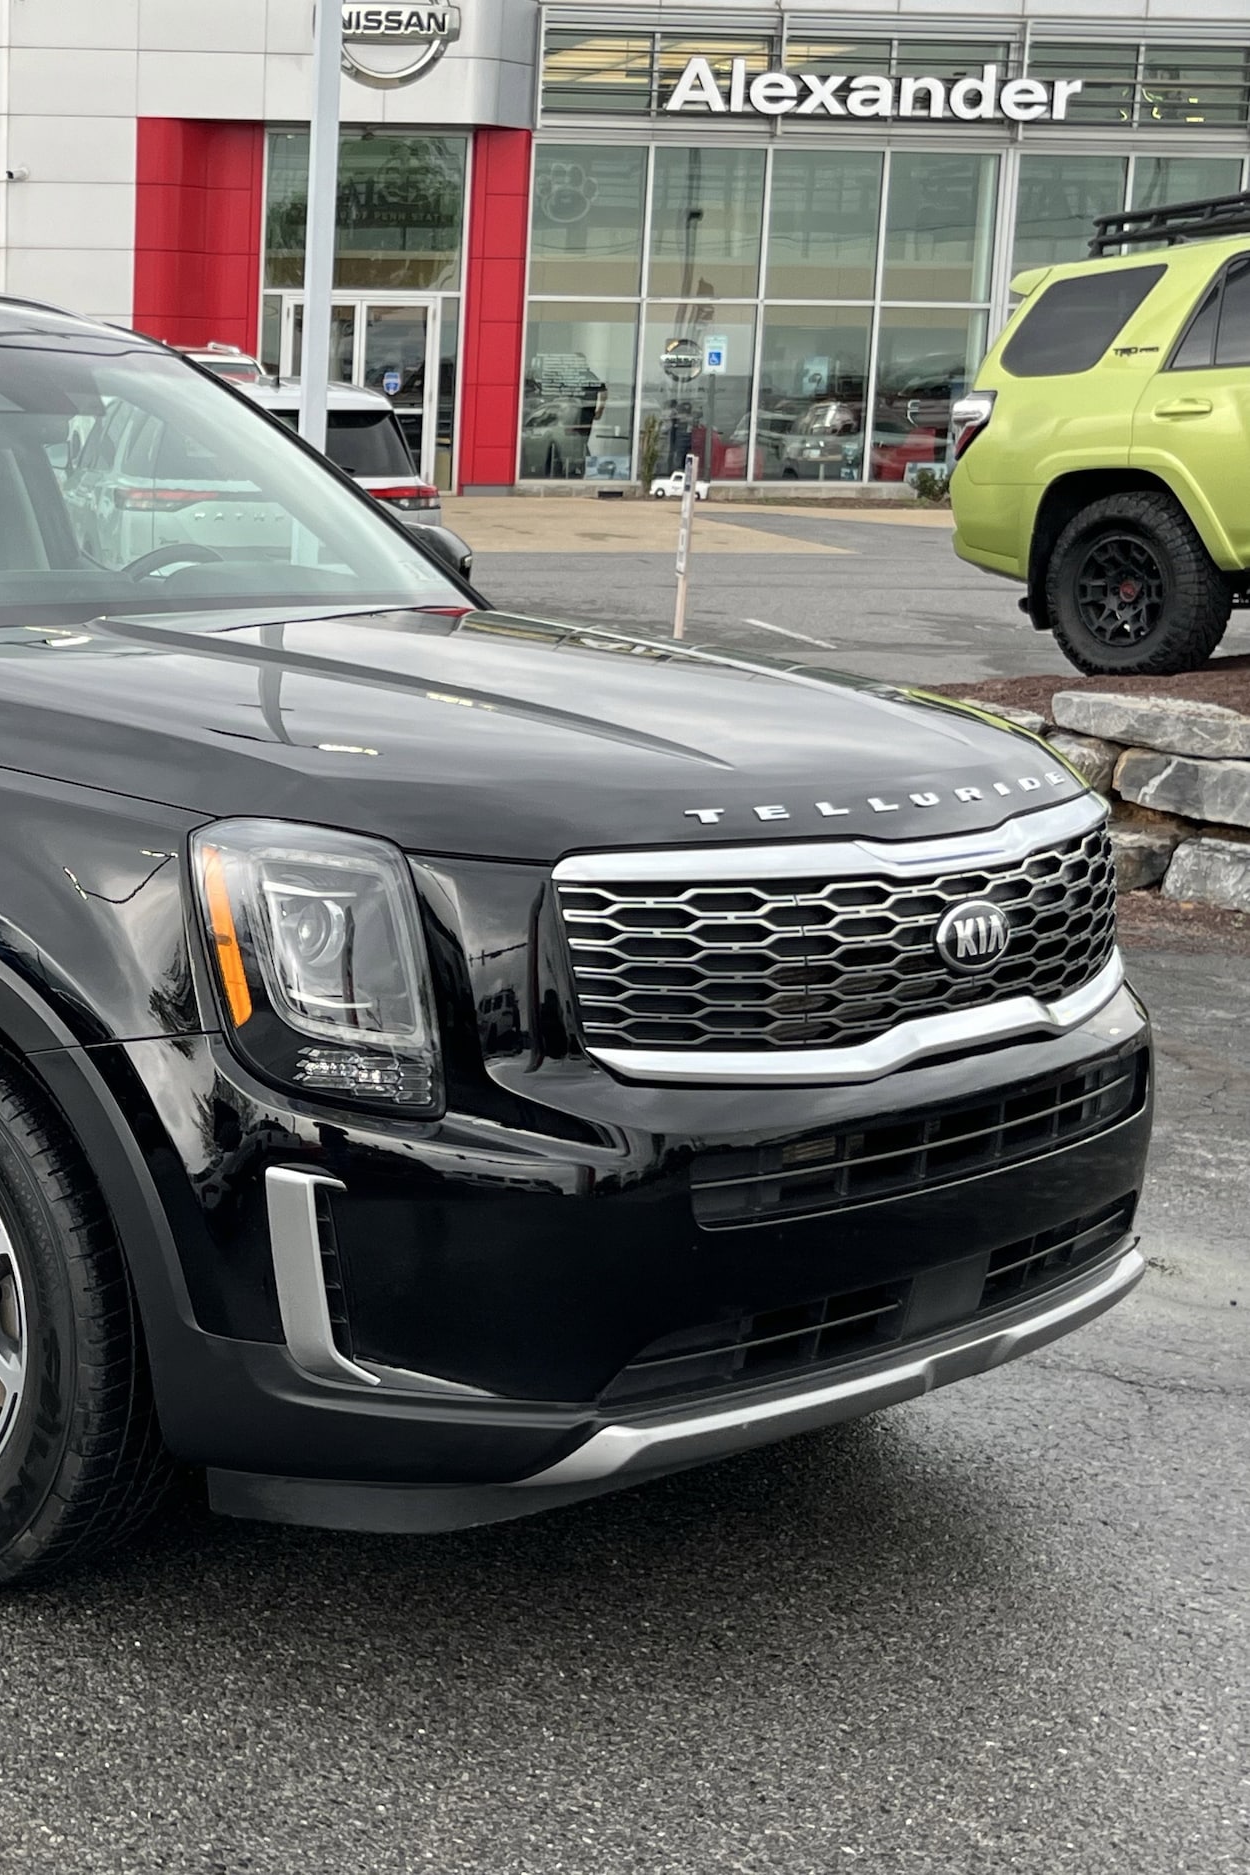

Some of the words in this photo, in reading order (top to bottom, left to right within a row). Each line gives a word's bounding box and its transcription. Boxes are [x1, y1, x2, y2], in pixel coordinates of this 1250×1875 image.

[665, 56, 1083, 121] Alexander
[684, 770, 1066, 825] TELLURIDE
[953, 914, 1005, 958] KIA
